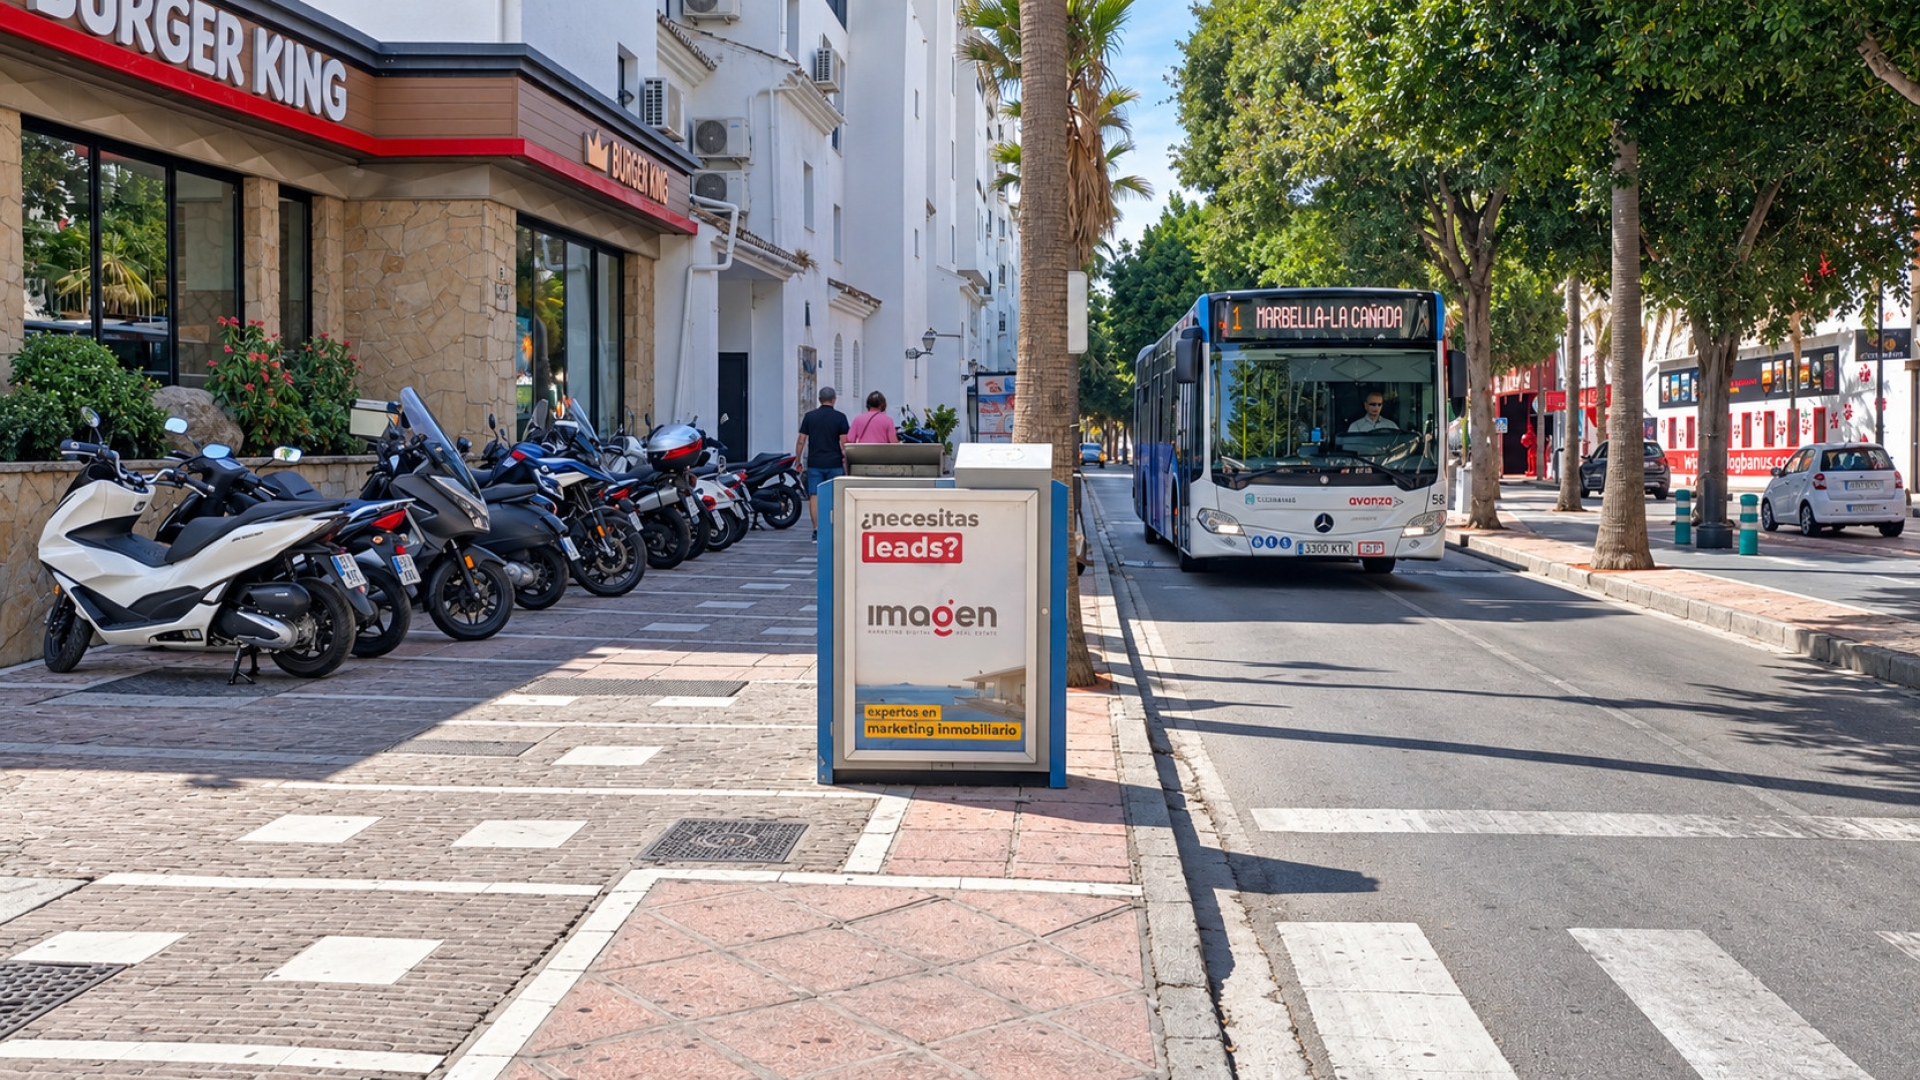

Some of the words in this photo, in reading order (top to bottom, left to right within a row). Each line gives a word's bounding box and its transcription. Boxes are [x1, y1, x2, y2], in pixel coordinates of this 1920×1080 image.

[27, 0, 245, 87] URGER
[252, 27, 348, 122] KING
[612, 141, 648, 196] BURGER
[649, 161, 669, 205] KING
[1232, 305, 1243, 331] 1
[1256, 306, 1348, 329] MARBELLA-LA
[1351, 303, 1403, 329] CAÑADA
[861, 508, 980, 530] ¿necesitas
[868, 535, 960, 559] leads?
[1305, 544, 1329, 554] 3300
[1331, 544, 1350, 554] KTK
[868, 599, 998, 637] imagen
[867, 708, 919, 719] expertos
[921, 709, 937, 717] en
[867, 722, 935, 737] marketing
[938, 723, 1018, 736] inmobiliario
